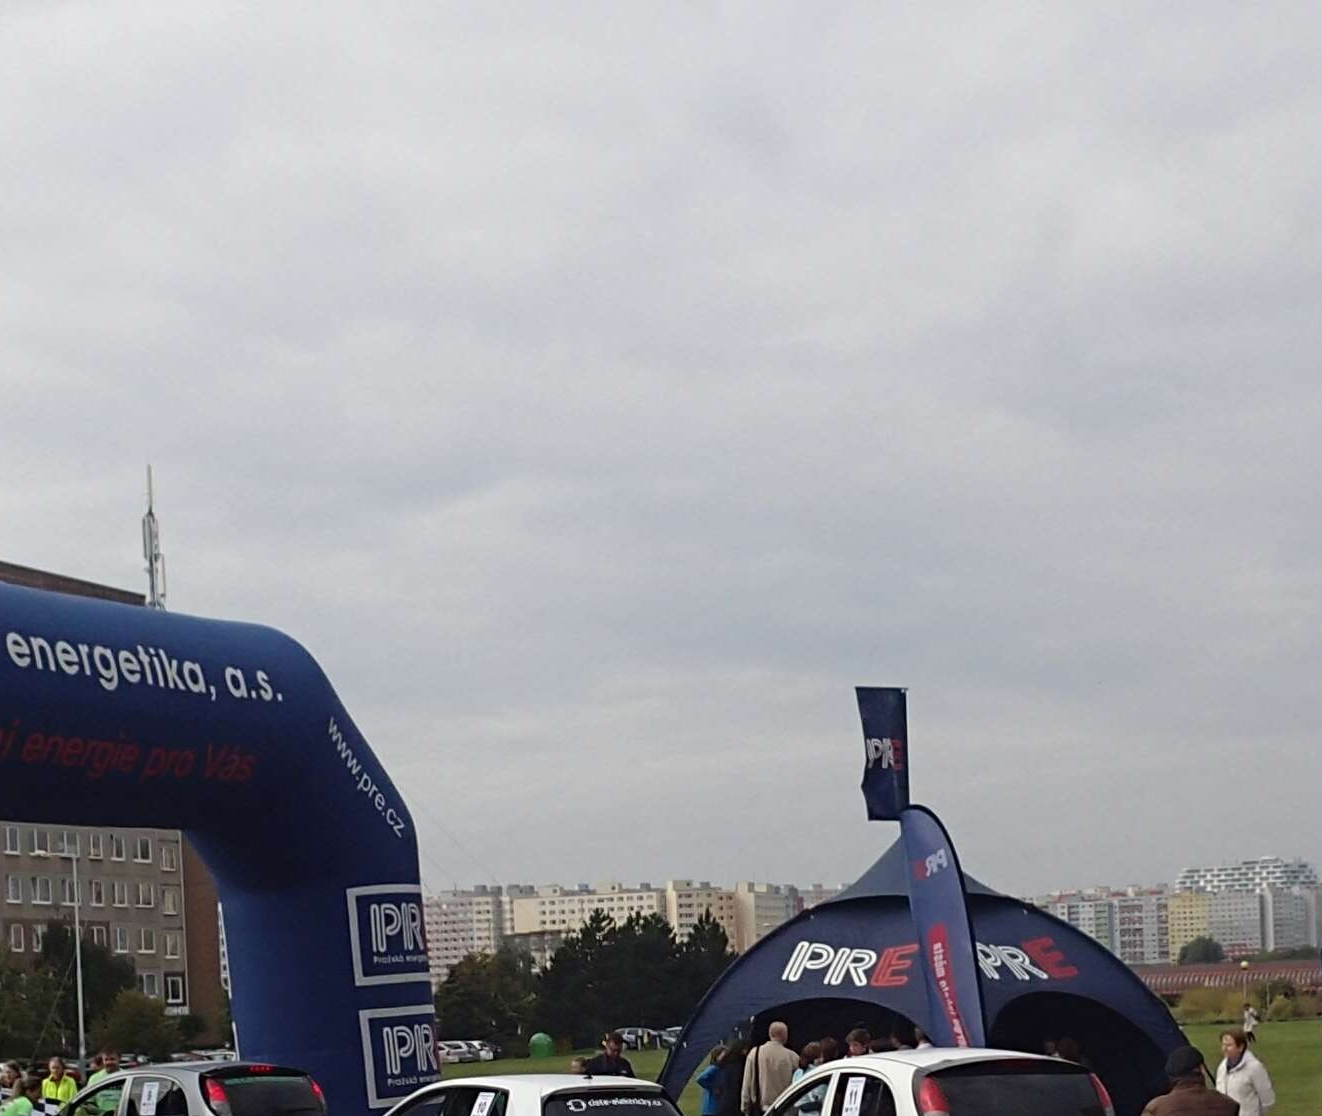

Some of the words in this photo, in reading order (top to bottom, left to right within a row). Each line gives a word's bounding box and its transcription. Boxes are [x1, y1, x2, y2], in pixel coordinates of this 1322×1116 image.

[5, 631, 217, 701] energetika,
[224, 665, 283, 701] a.s.
[19, 729, 139, 780] energie
[139, 744, 197, 784] pro
[203, 741, 258, 782] Vás
[327, 716, 405, 838] www.pre.cz
[370, 902, 428, 953] PR
[781, 940, 919, 988] PRE
[382, 1024, 439, 1076] PR
